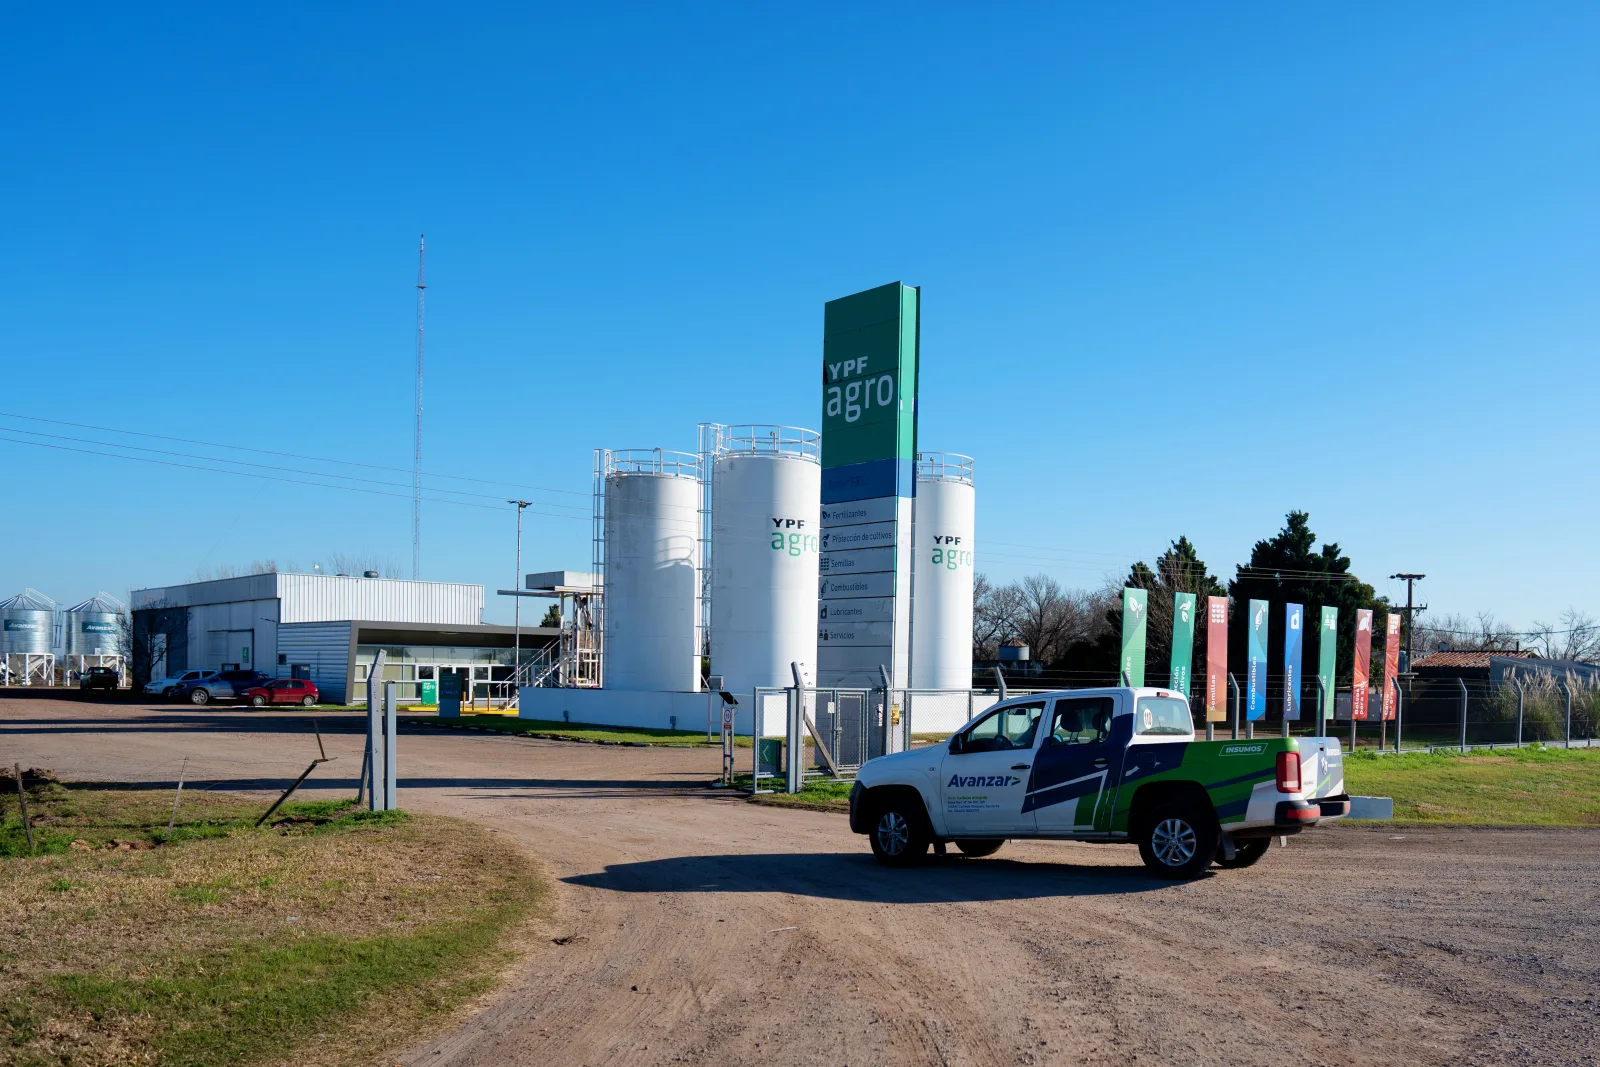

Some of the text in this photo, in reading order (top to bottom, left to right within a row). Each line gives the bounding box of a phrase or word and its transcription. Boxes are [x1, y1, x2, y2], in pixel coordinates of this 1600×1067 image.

[829, 356, 868, 380] YPF
[827, 375, 893, 422] agro
[832, 510, 867, 519] Fertilizantes
[772, 518, 805, 529] YPF
[832, 531, 892, 543] Protección de cultivos
[932, 535, 961, 545] YPF
[772, 532, 818, 556] agro
[831, 559, 855, 568] Semillas
[931, 548, 972, 570] agro
[830, 582, 868, 592] Combustibles
[830, 607, 863, 616] Lubricantes
[830, 631, 855, 640] Servicios
[1225, 745, 1262, 753] INSUMOS
[947, 774, 1012, 787] Avanzar
